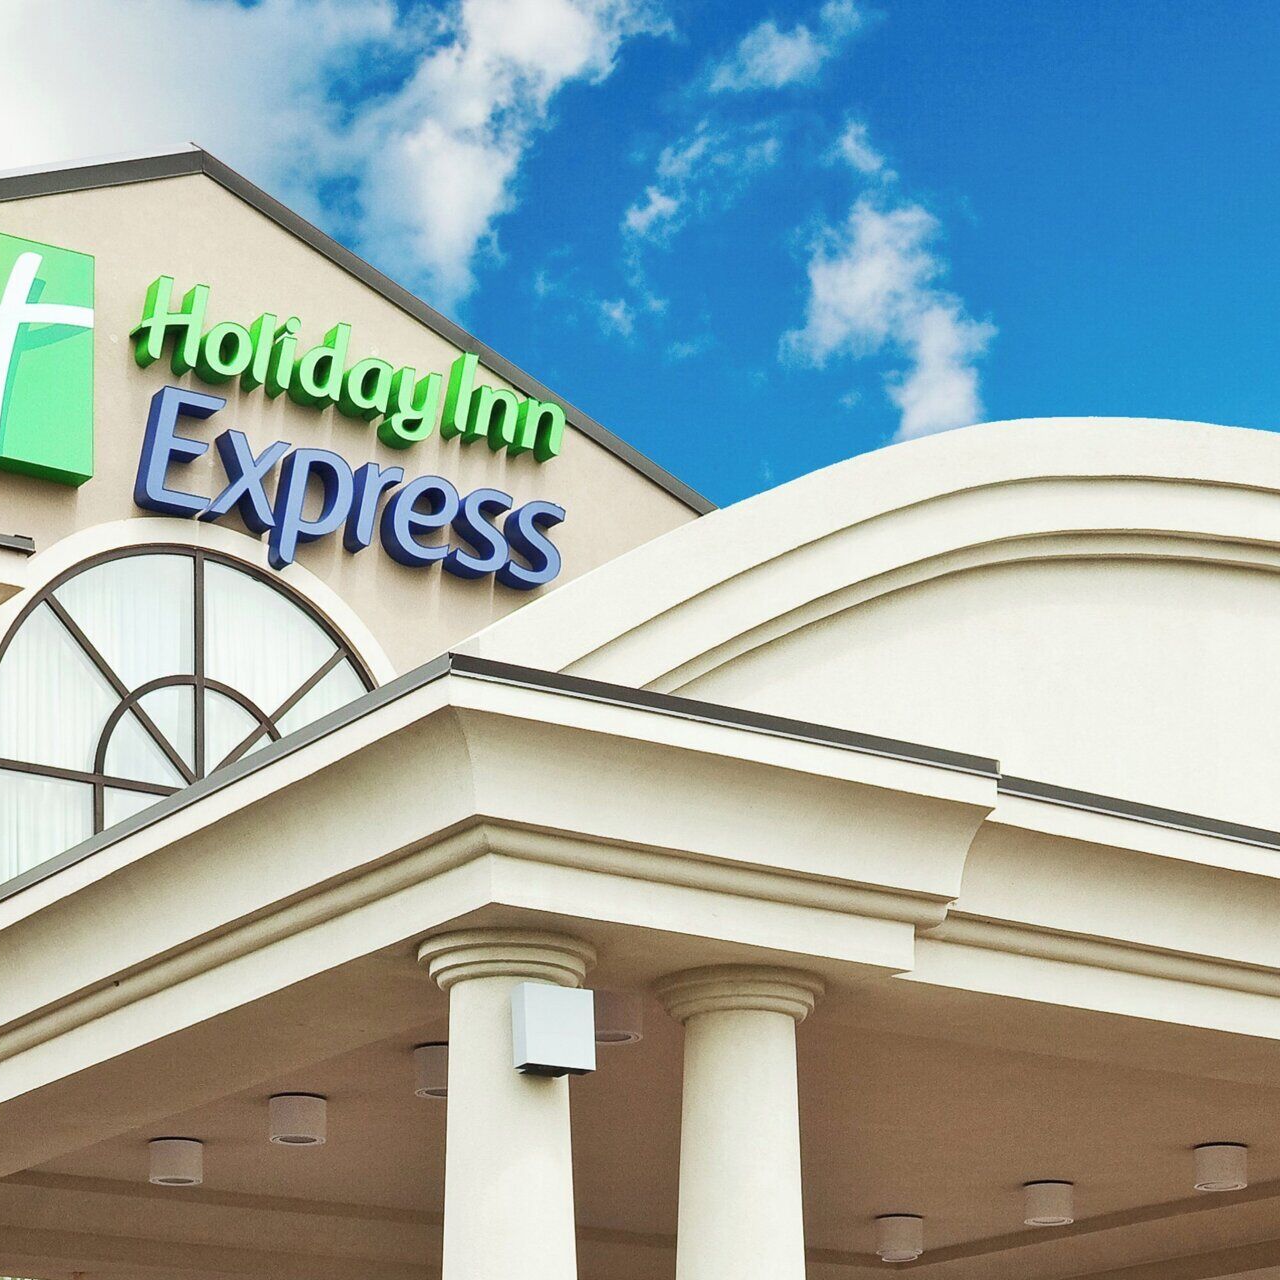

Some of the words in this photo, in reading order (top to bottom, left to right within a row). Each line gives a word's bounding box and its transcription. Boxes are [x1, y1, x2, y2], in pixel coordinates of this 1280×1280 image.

[129, 275, 443, 449] Holiday
[440, 352, 566, 463] Inn
[134, 385, 566, 590] Express
